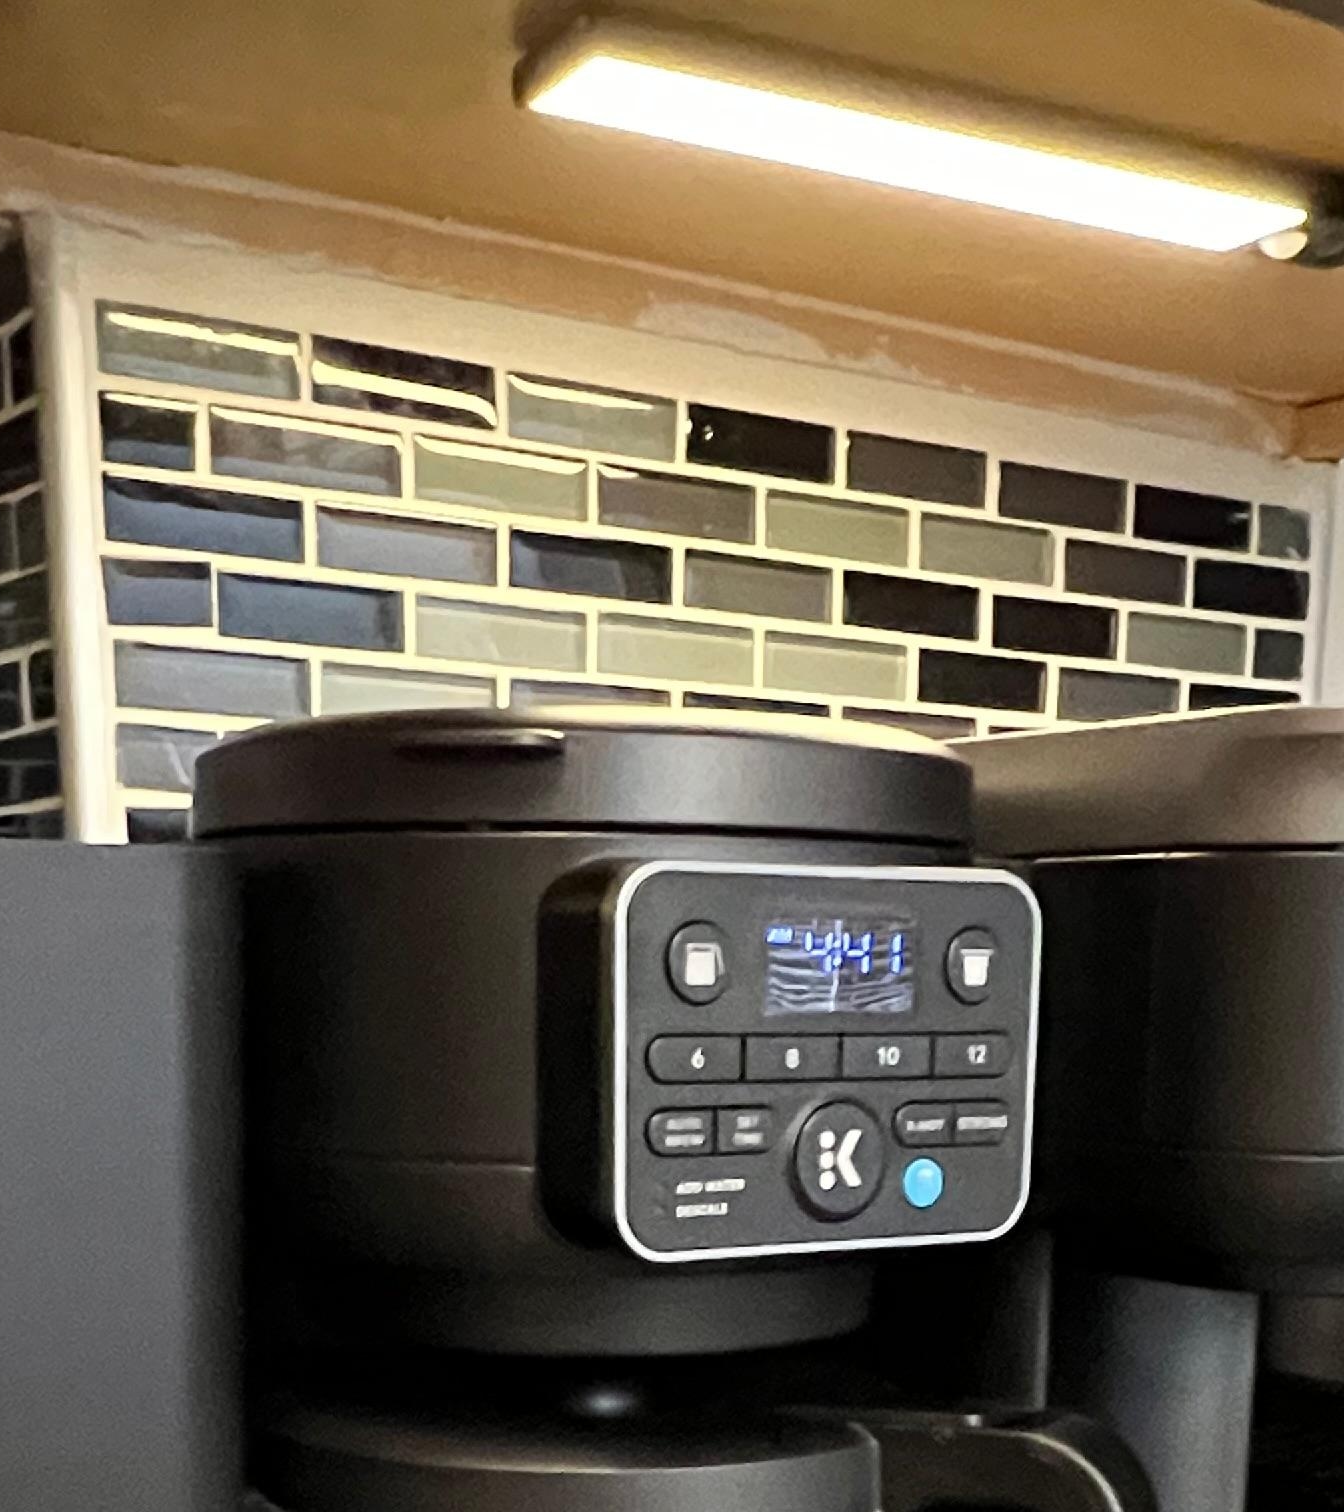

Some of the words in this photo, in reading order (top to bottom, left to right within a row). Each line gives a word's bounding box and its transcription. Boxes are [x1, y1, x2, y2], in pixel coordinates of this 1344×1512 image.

[804, 931, 903, 975] 4:41
[691, 1047, 705, 1069] 6
[877, 1046, 900, 1067] 10
[967, 1044, 987, 1064] 12
